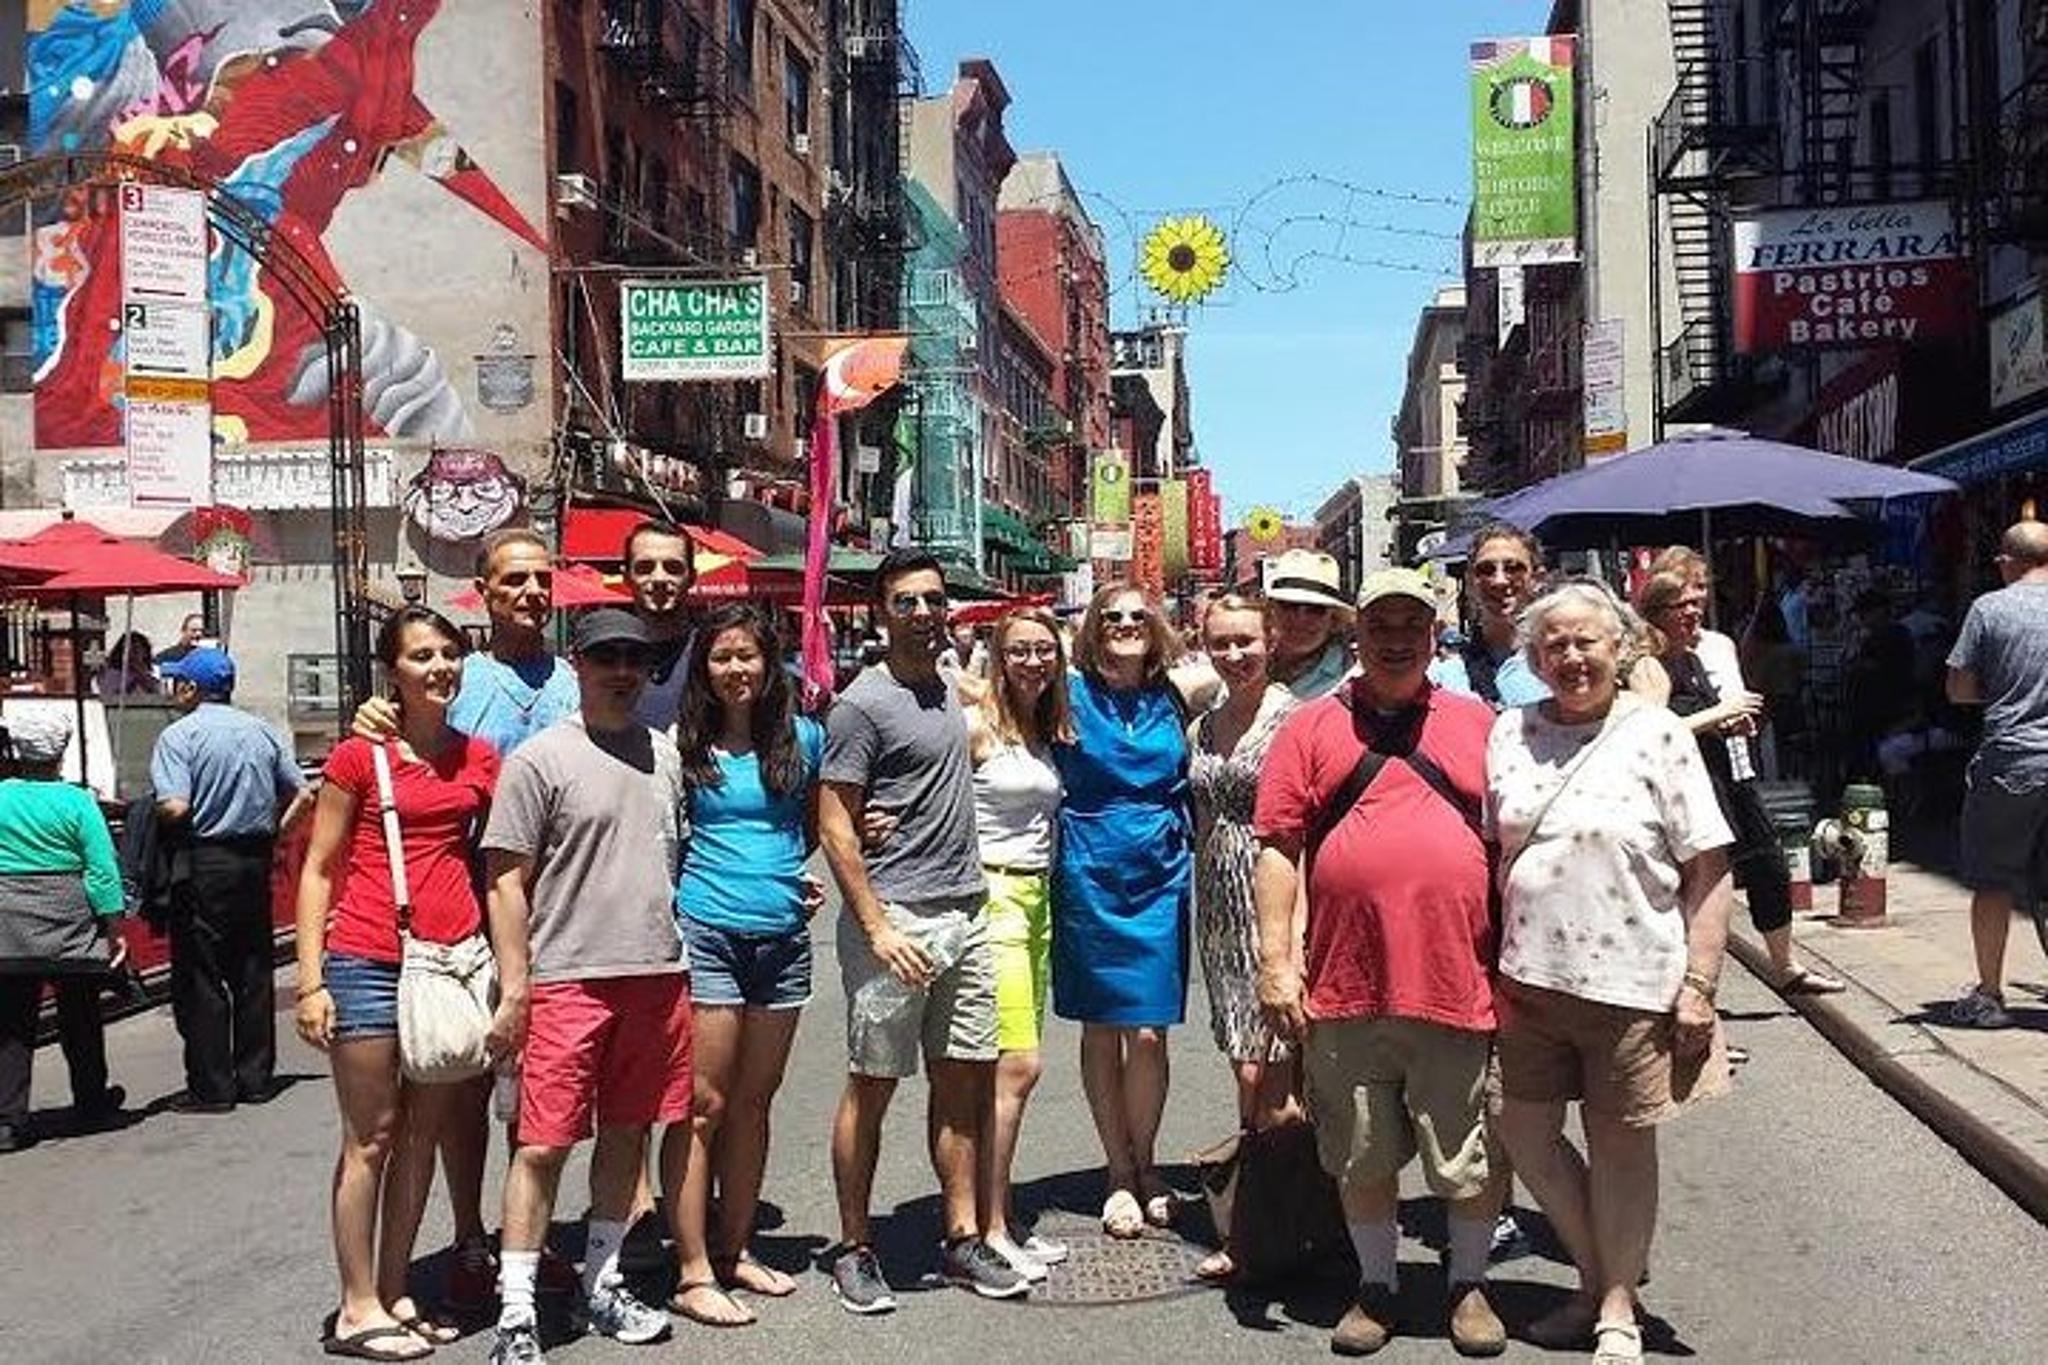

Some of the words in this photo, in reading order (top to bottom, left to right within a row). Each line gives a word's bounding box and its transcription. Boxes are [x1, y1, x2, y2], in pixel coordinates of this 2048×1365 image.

[1476, 136, 1565, 156] WELCOME
[126, 188, 140, 210] 3
[1790, 213, 1835, 236] La
[1849, 208, 1912, 232] bella
[1750, 233, 1958, 268] FERRARA
[1773, 265, 1929, 295] Pastries
[631, 289, 681, 316] CHA
[687, 286, 761, 316] CHA'S
[1810, 288, 1894, 317] Café
[128, 307, 143, 329] 2
[631, 321, 703, 337] BACKYARD
[705, 319, 761, 336] GARDEN
[1789, 317, 1918, 344] Bakery
[631, 340, 687, 355] CAFE
[693, 339, 709, 354] &
[713, 338, 760, 354] BAR
